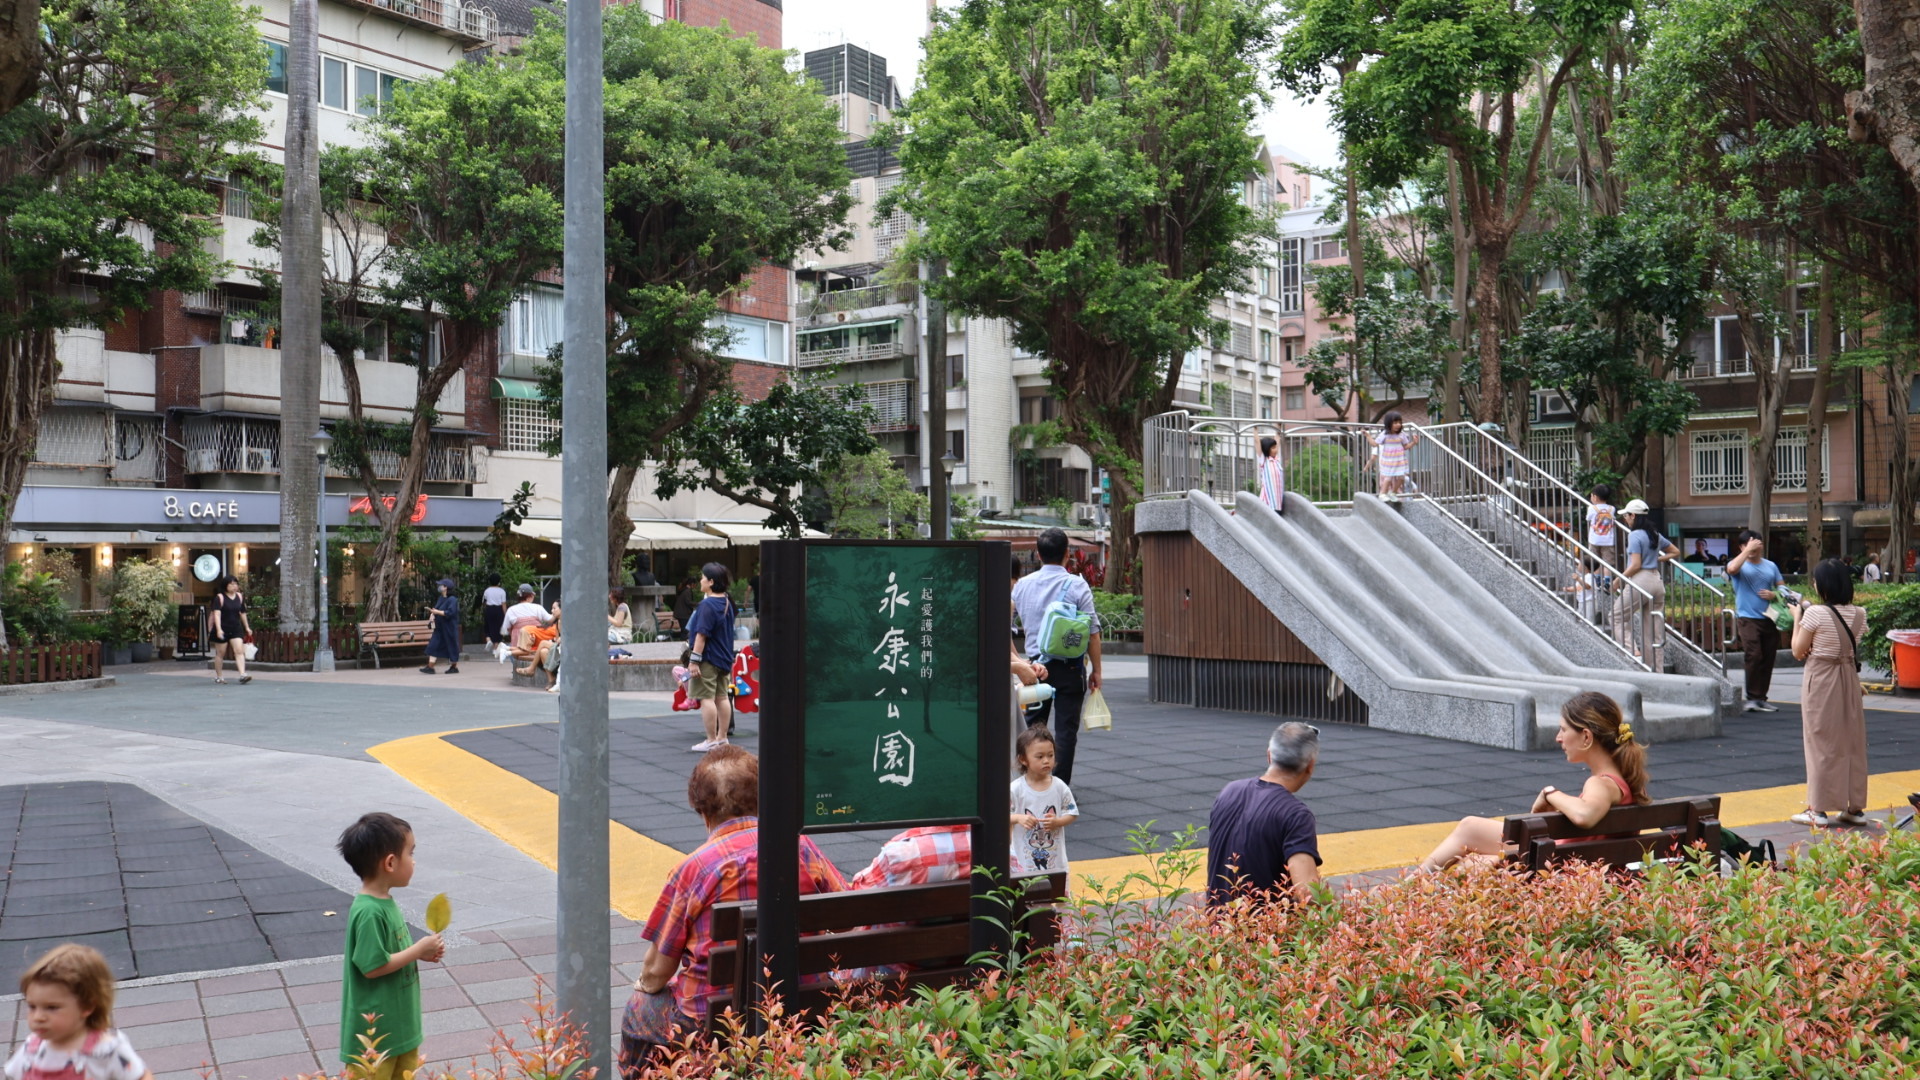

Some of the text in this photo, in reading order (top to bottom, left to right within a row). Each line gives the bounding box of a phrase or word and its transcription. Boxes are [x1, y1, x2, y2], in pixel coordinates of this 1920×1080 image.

[189, 499, 239, 518] CAFÉ
[873, 571, 915, 787] 永康公園
[920, 576, 934, 679] 一起愛護我們的
